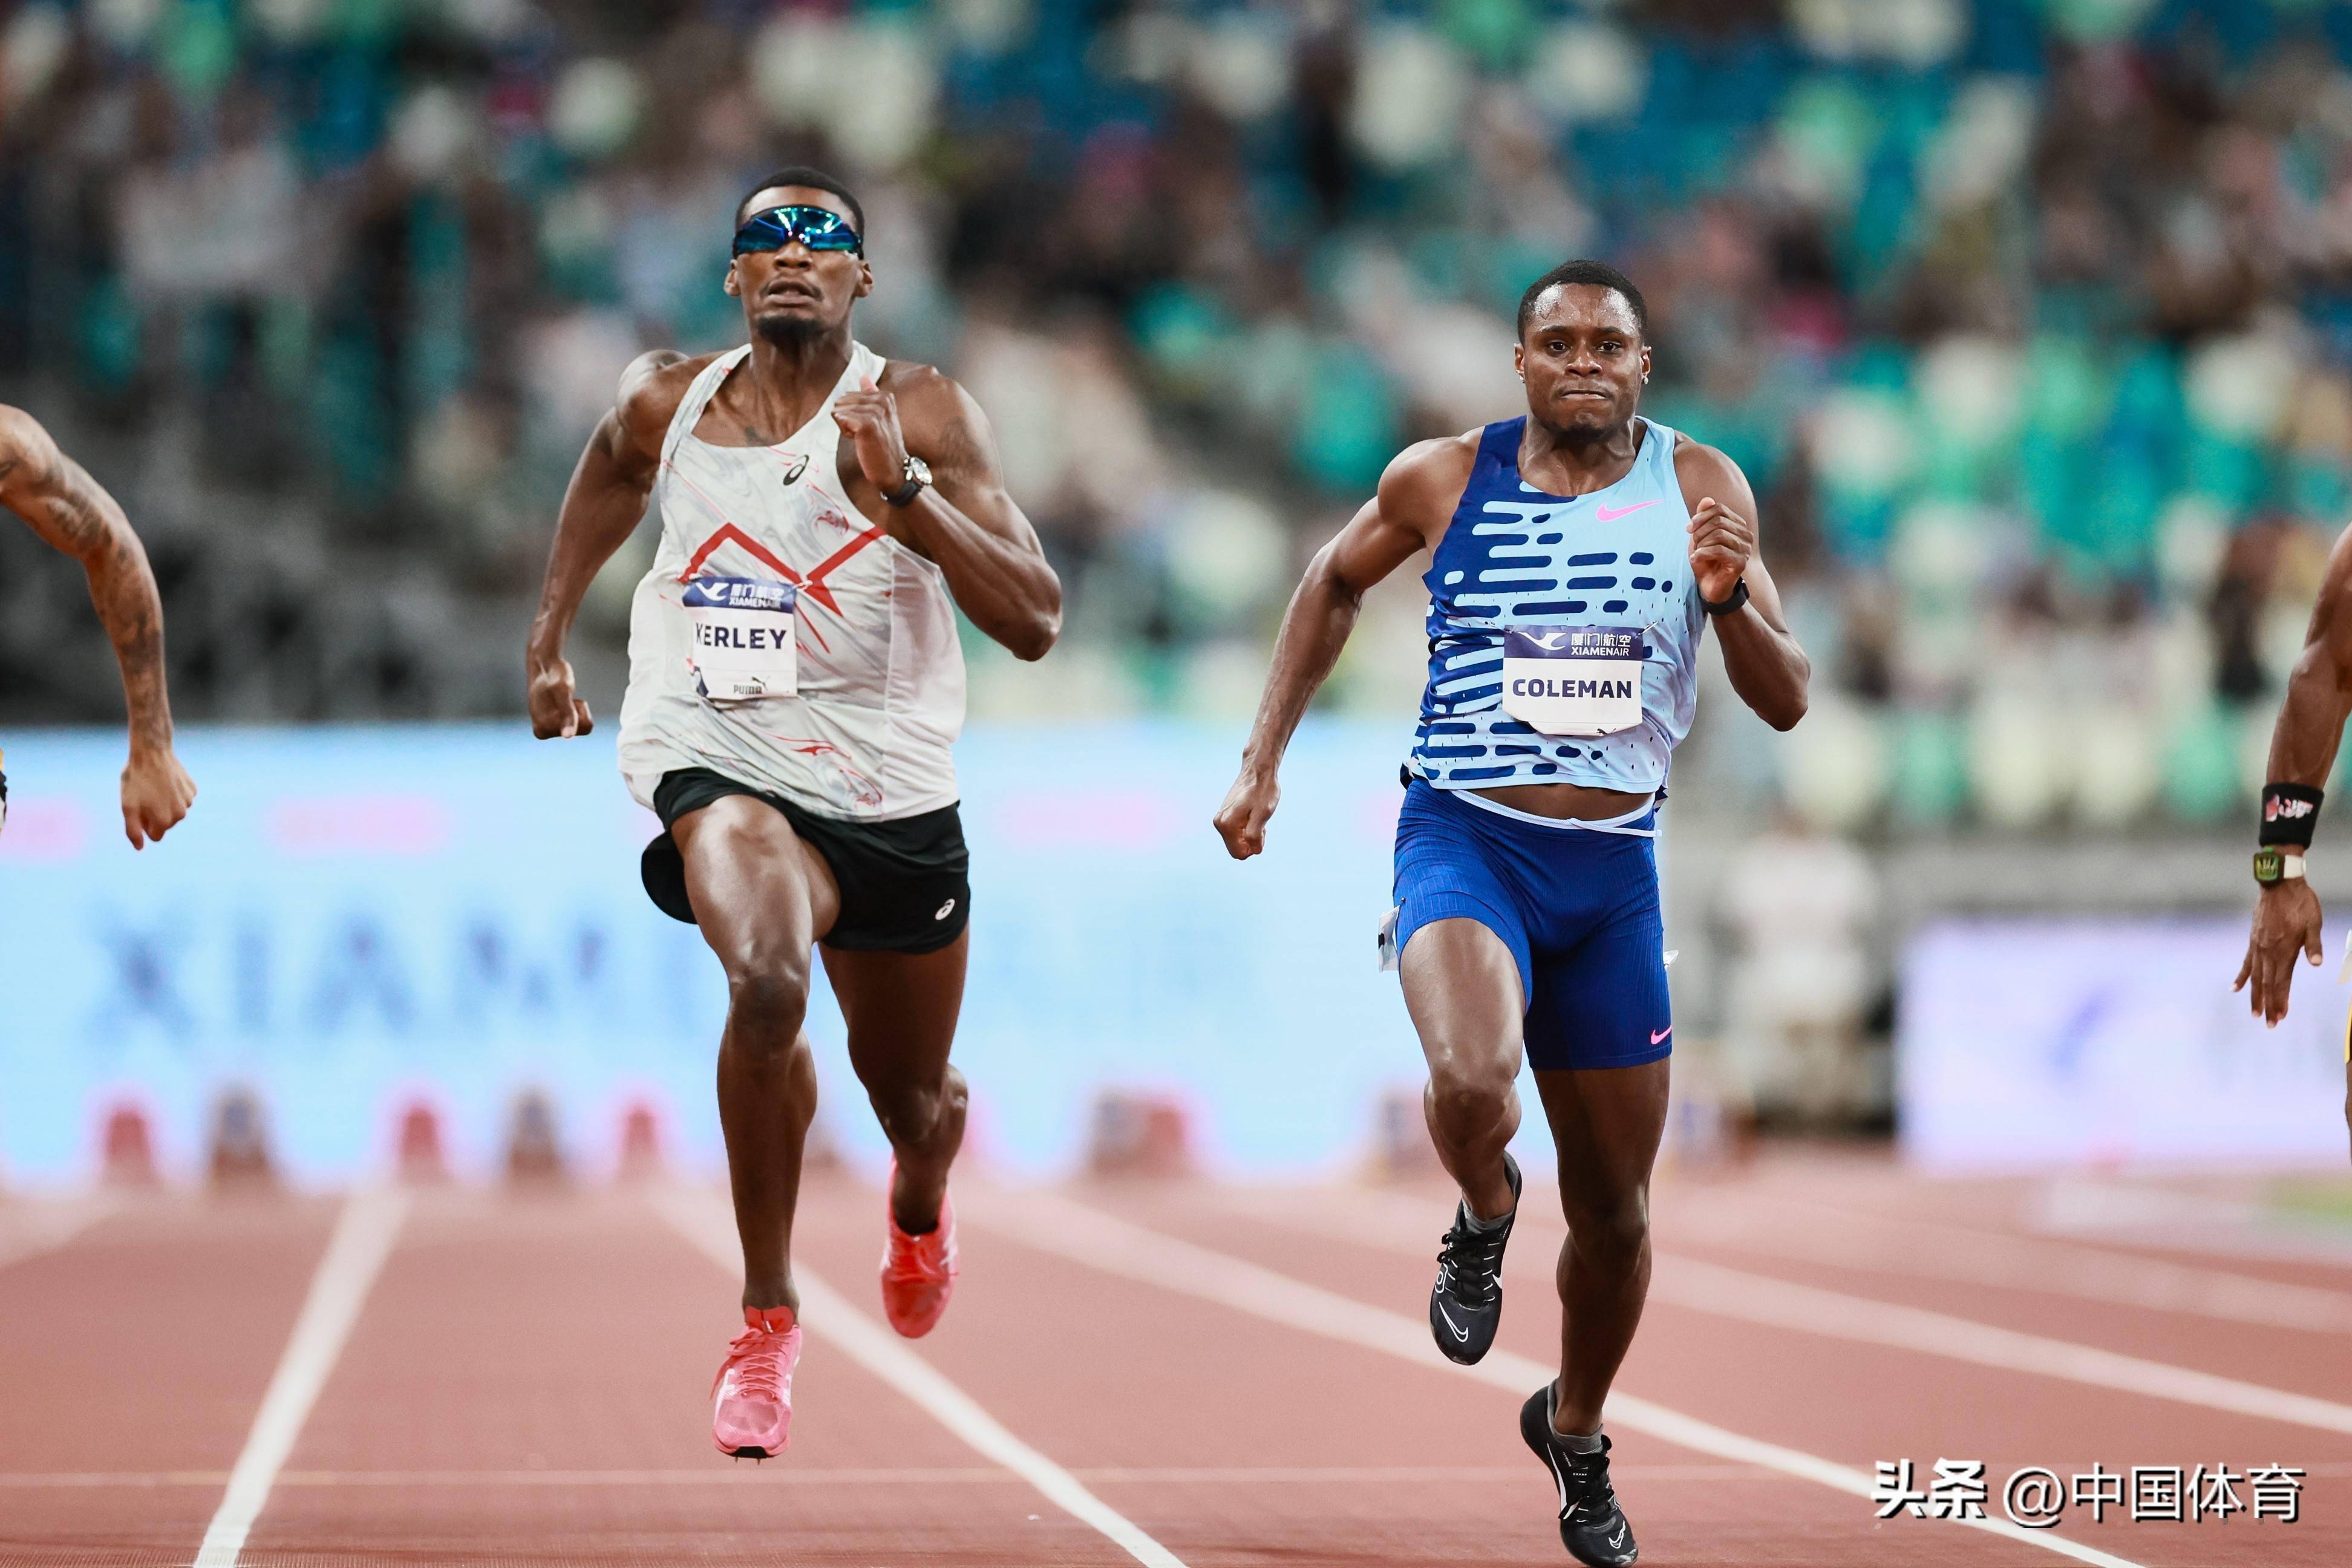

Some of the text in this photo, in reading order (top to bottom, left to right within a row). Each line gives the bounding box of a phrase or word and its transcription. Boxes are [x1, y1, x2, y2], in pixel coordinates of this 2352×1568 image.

[1570, 633, 1632, 648] 厦门航空
[1570, 647, 1630, 657] XIAMENAIR
[1512, 678, 1632, 699] COLEMAN
